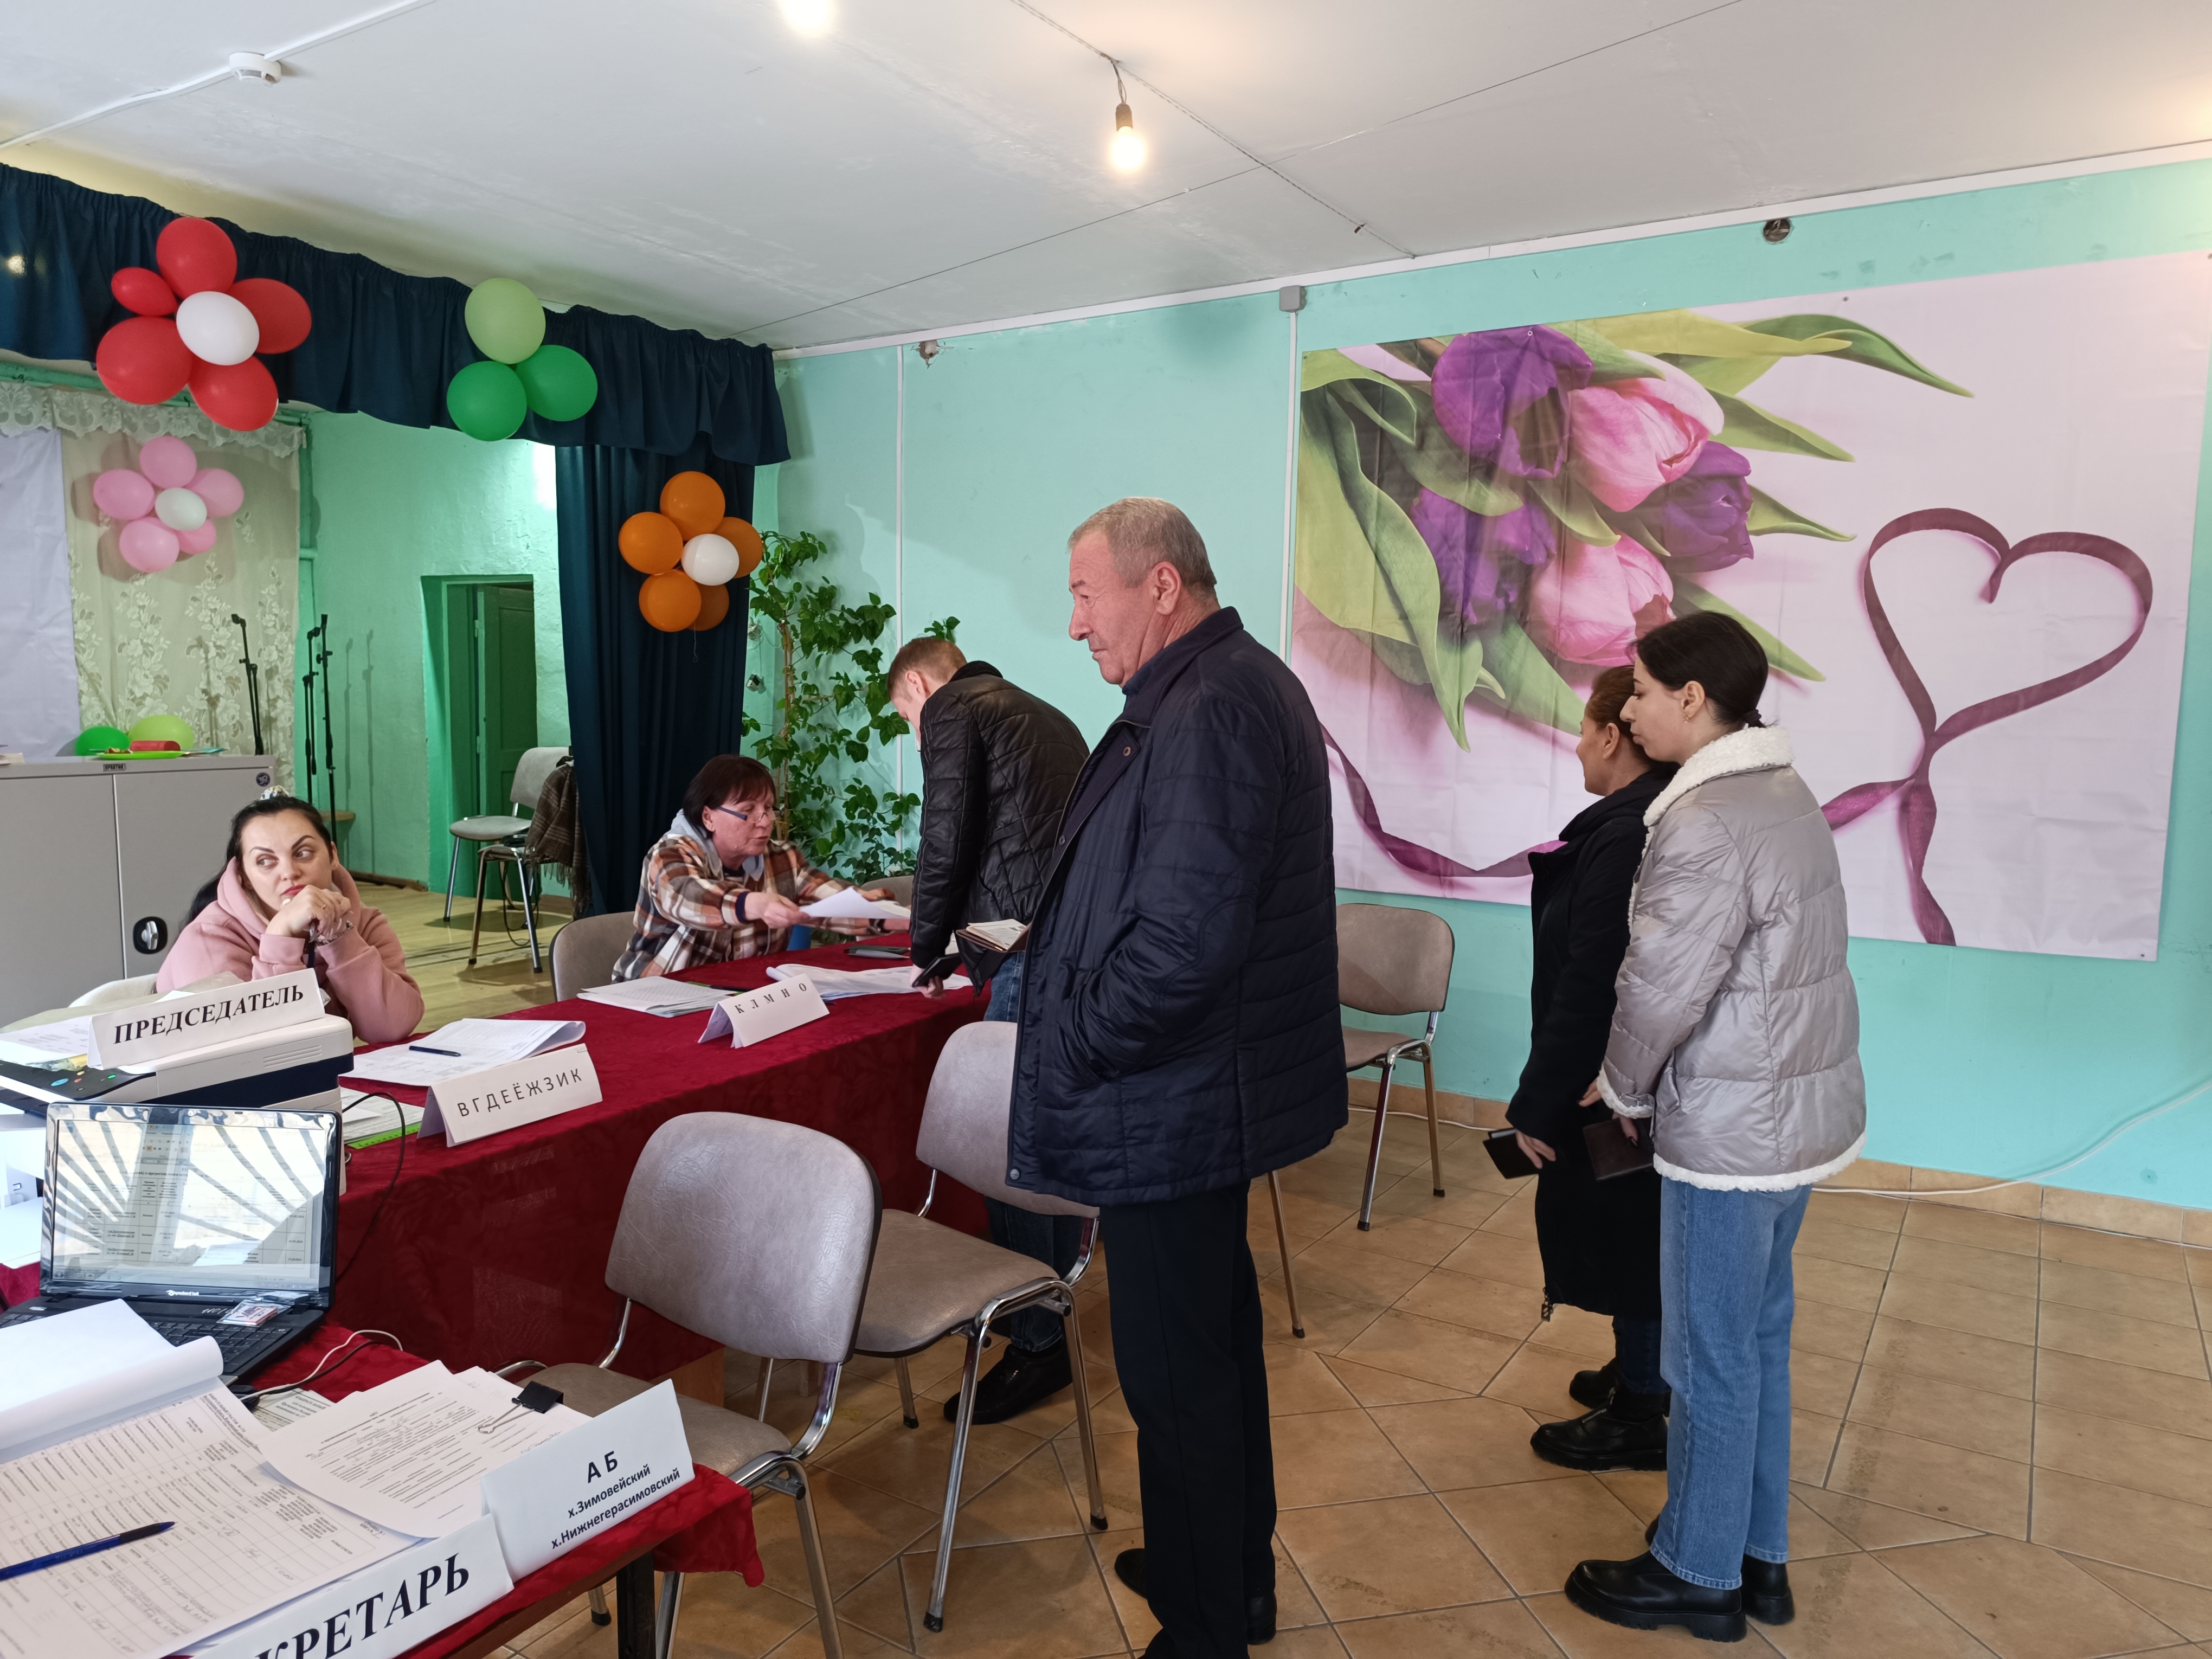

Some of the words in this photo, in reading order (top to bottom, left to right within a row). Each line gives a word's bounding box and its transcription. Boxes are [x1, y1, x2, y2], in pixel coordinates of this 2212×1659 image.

[113, 985, 304, 1045] ПРЕДСЕДАТЕЛЬ
[551, 1467, 681, 1549] х.Нижнегерасимовский
[567, 1463, 651, 1519] х.Зимовейский
